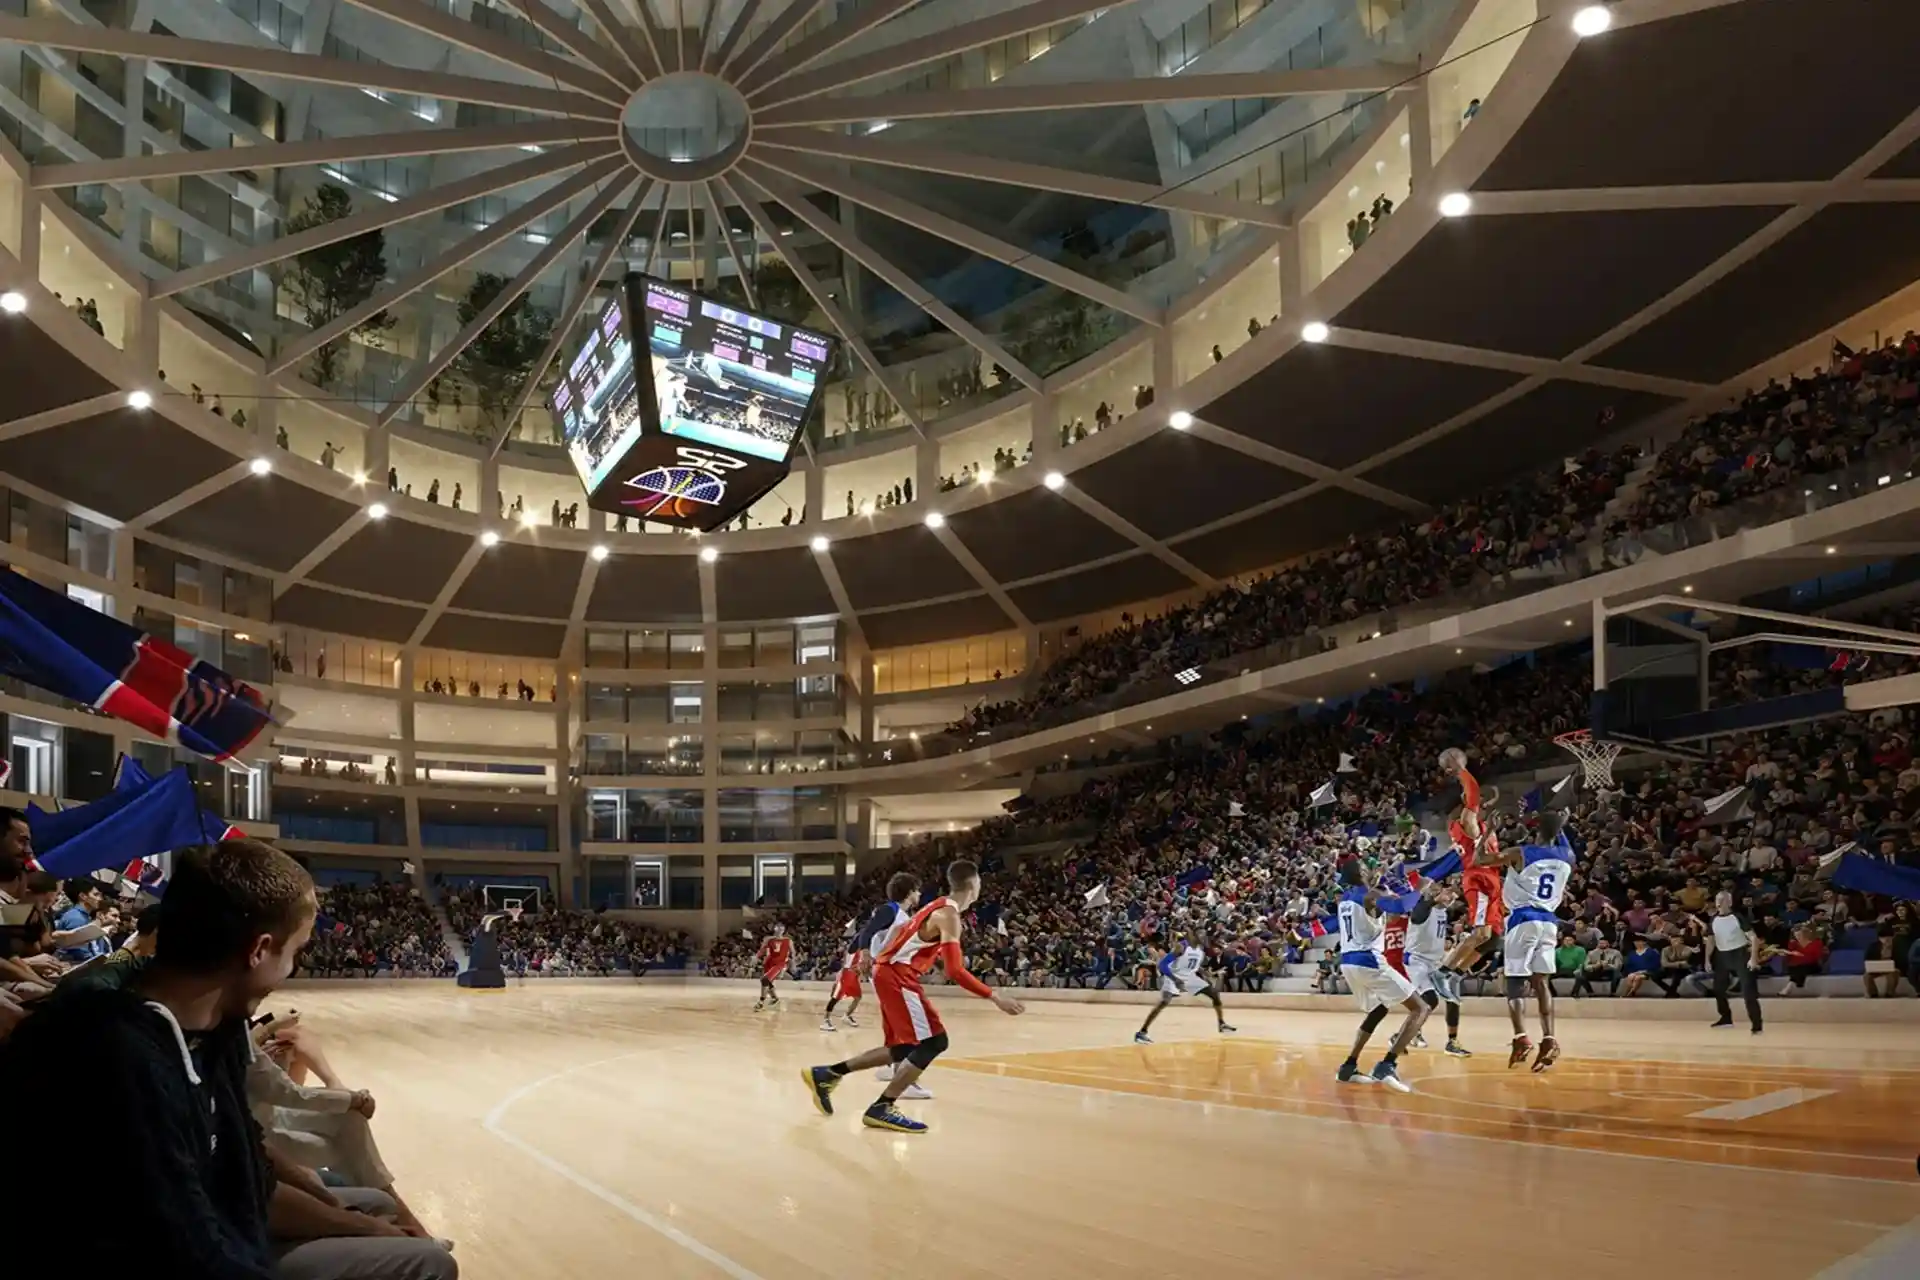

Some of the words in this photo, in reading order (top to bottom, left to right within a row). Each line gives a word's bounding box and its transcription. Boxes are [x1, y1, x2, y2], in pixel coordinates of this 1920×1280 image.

[648, 283, 690, 301] HOME
[793, 331, 827, 346] AWAY
[1537, 873, 1555, 900] 6
[1385, 929, 1406, 949] 23
